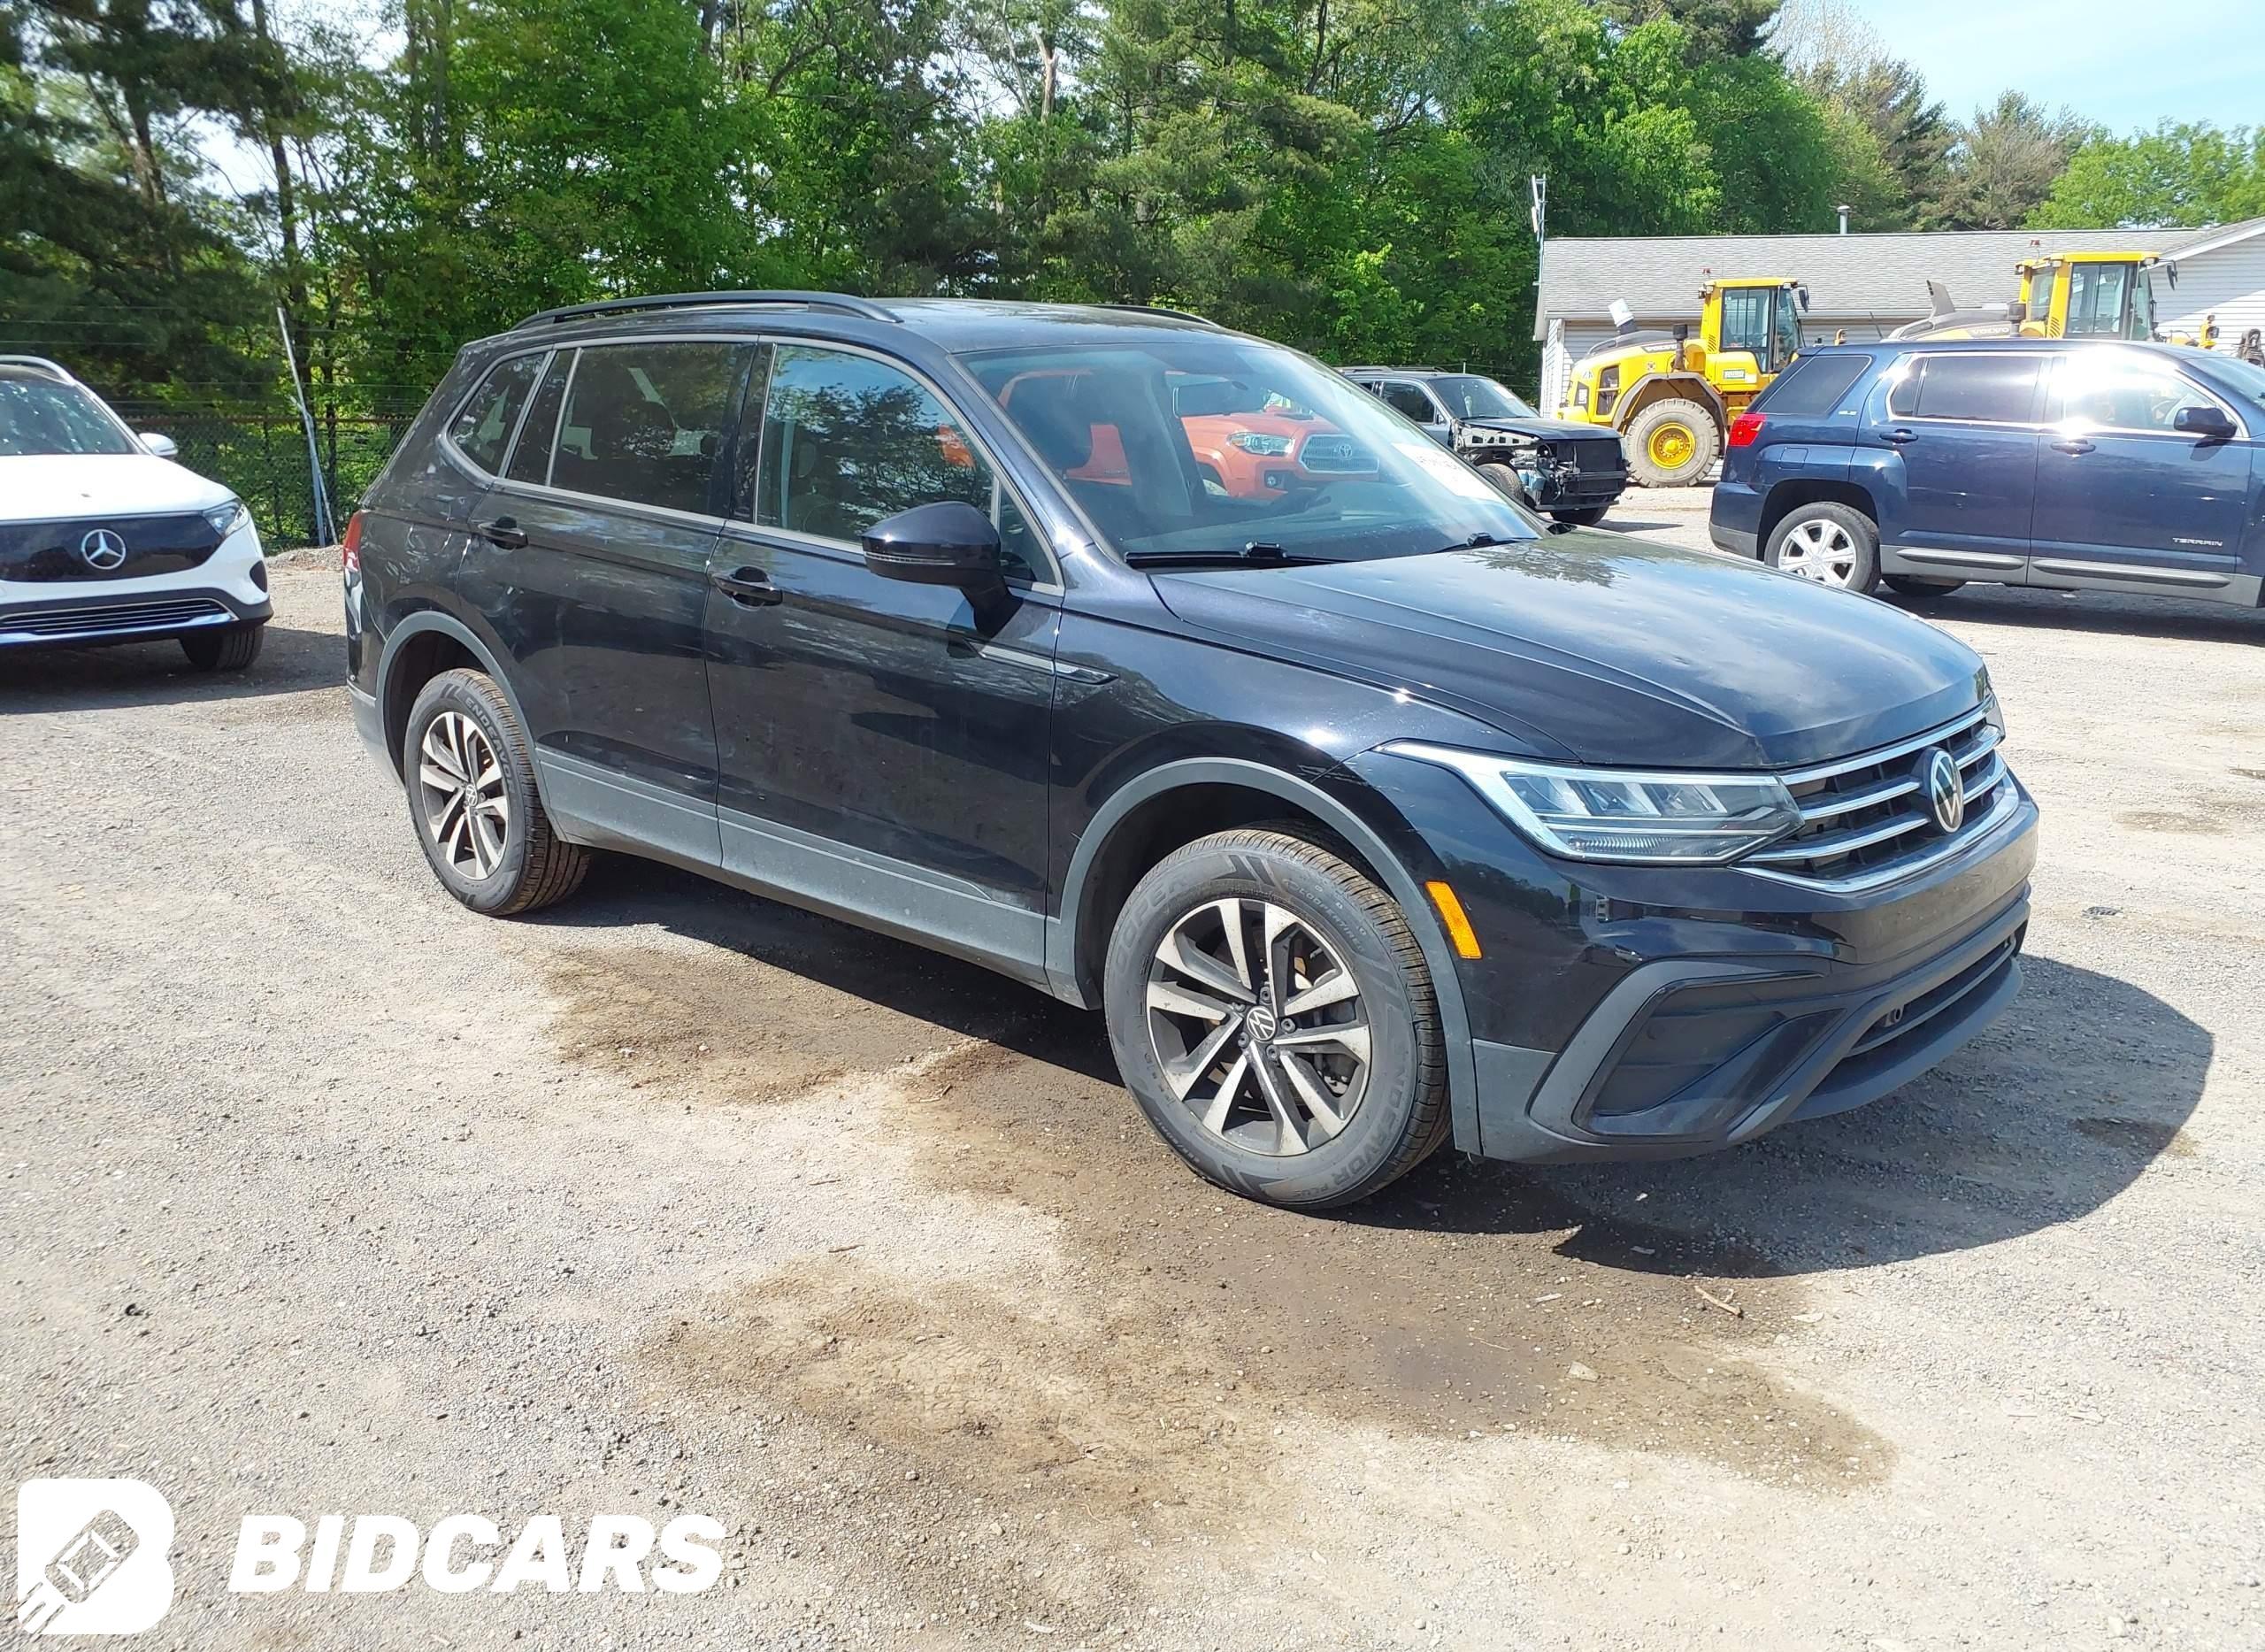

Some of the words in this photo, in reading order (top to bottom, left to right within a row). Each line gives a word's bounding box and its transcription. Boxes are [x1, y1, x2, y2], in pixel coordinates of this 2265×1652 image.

[2172, 537, 2223, 547] TERRAIN
[465, 696, 516, 795] ENDEAVOR
[1329, 1053, 1409, 1186] NDEAVOR
